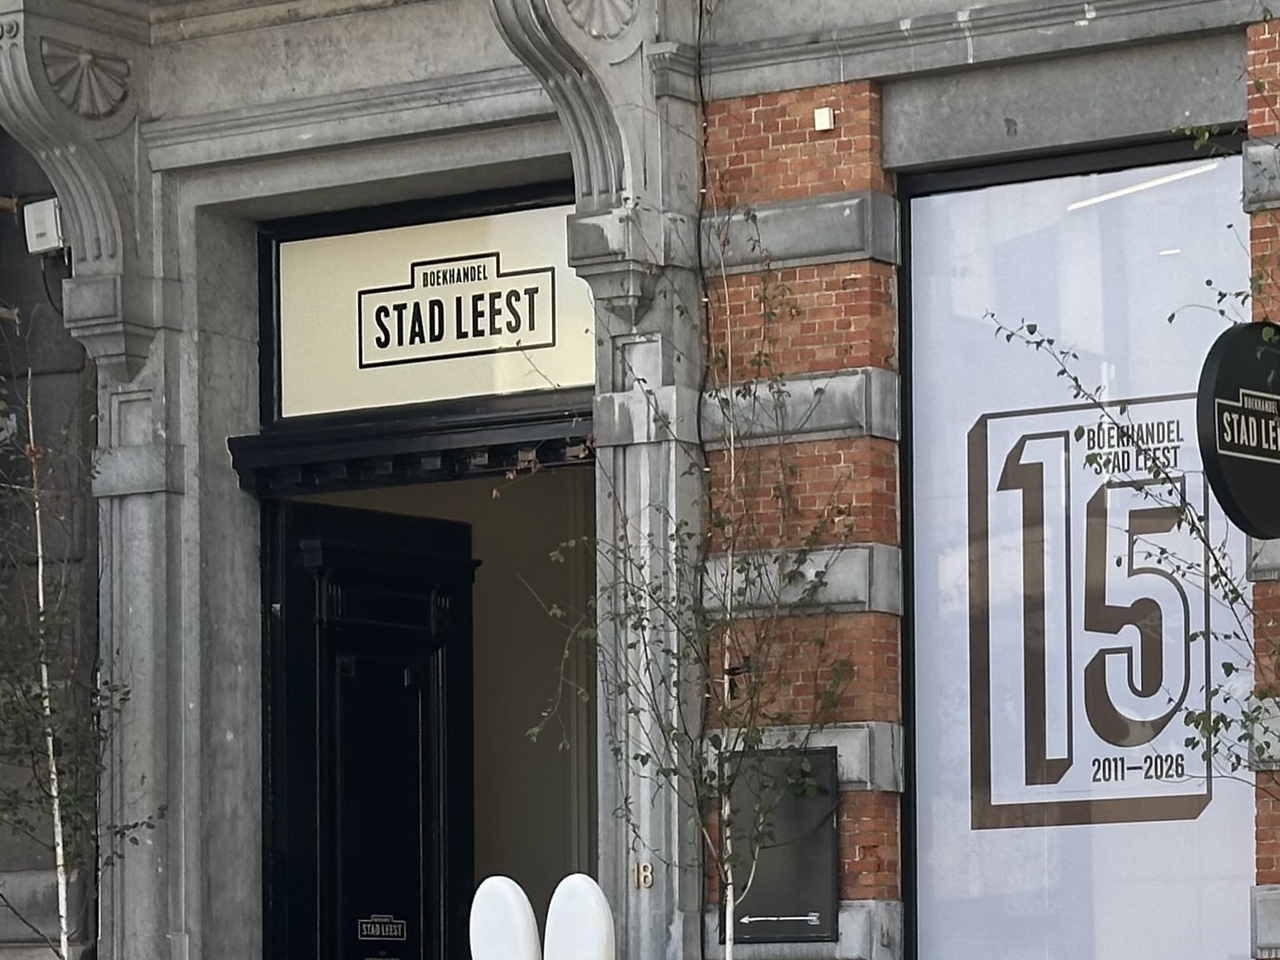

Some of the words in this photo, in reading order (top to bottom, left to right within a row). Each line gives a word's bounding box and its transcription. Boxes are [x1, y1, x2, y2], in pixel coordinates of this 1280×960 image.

[422, 264, 488, 288] BOEKHANDEL
[375, 299, 445, 349] STAD
[455, 286, 539, 340] LEEST
[1086, 420, 1184, 450] BOEKHANDEL
[1223, 411, 1257, 447] STAD
[1094, 450, 1130, 475] STAD
[1135, 445, 1182, 472] LEEST
[997, 430, 1191, 786] 15
[634, 862, 654, 889] 18
[362, 923, 380, 936] STAD
[381, 924, 402, 937] LEEST
